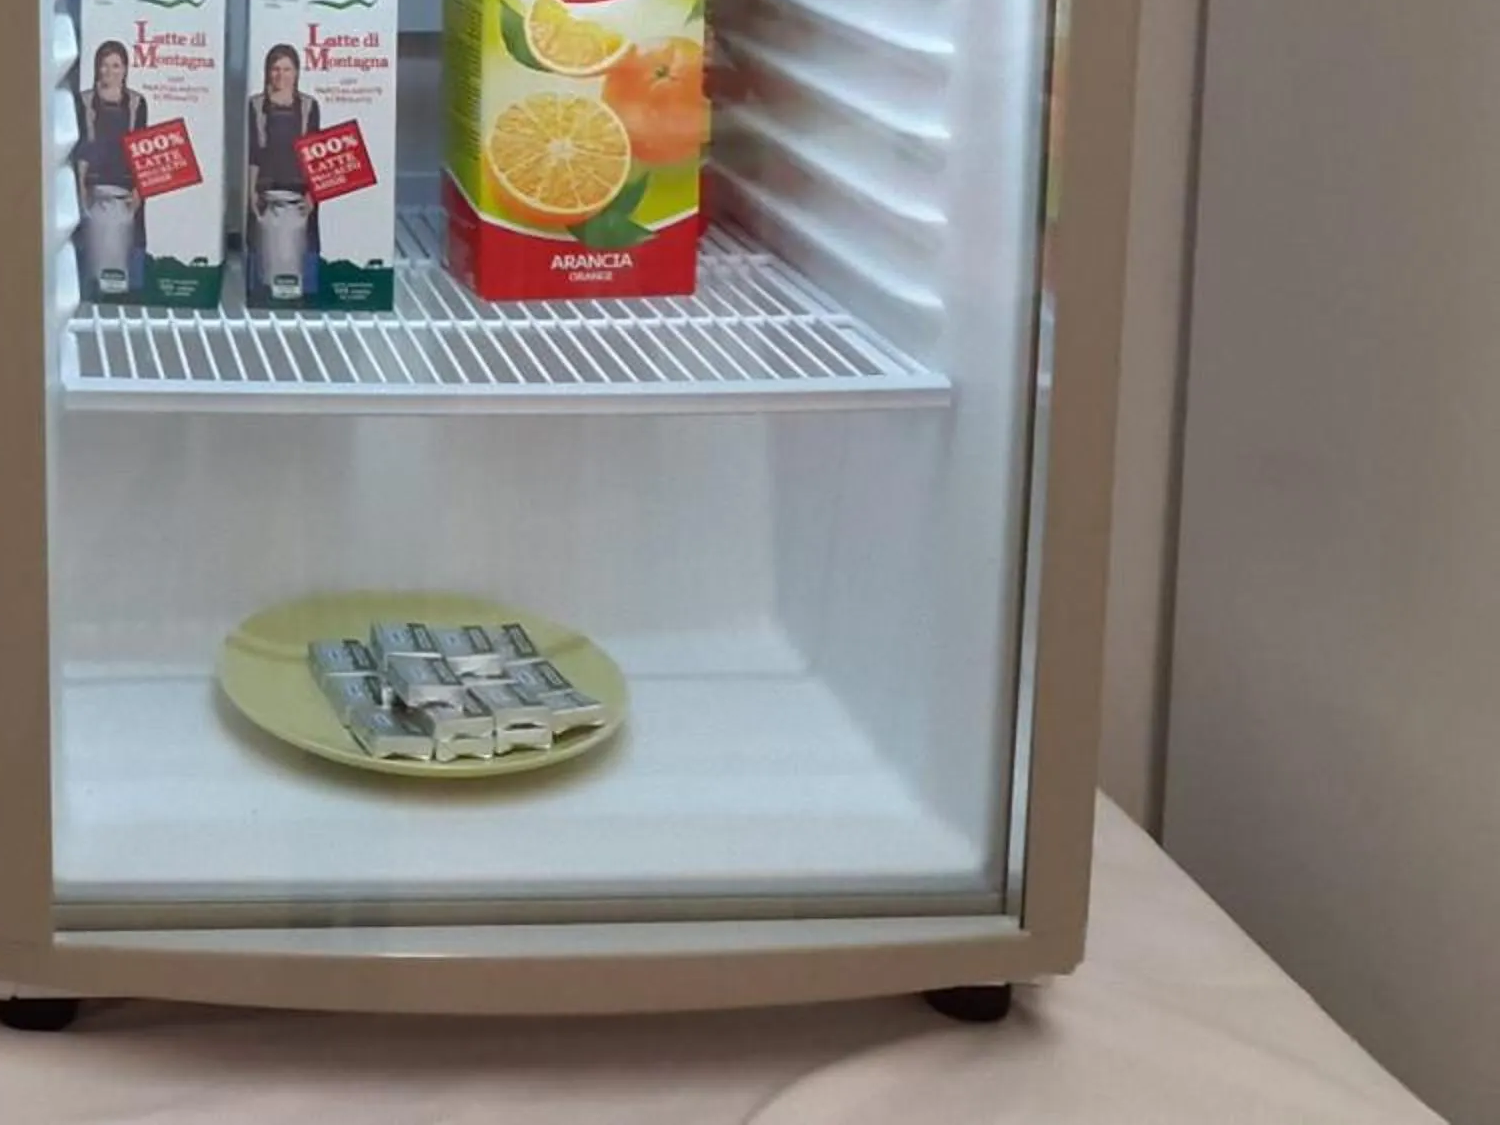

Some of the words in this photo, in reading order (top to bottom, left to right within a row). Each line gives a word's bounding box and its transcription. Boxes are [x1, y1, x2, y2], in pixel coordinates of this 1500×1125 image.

[133, 20, 187, 46] Latte
[190, 31, 206, 47] di
[307, 23, 360, 47] Latte
[363, 31, 380, 47] di
[132, 44, 215, 72] Montagna
[303, 47, 389, 72] Montagna
[128, 131, 186, 158] 100%
[300, 133, 359, 162] 100%
[550, 252, 634, 271] ARANCIA
